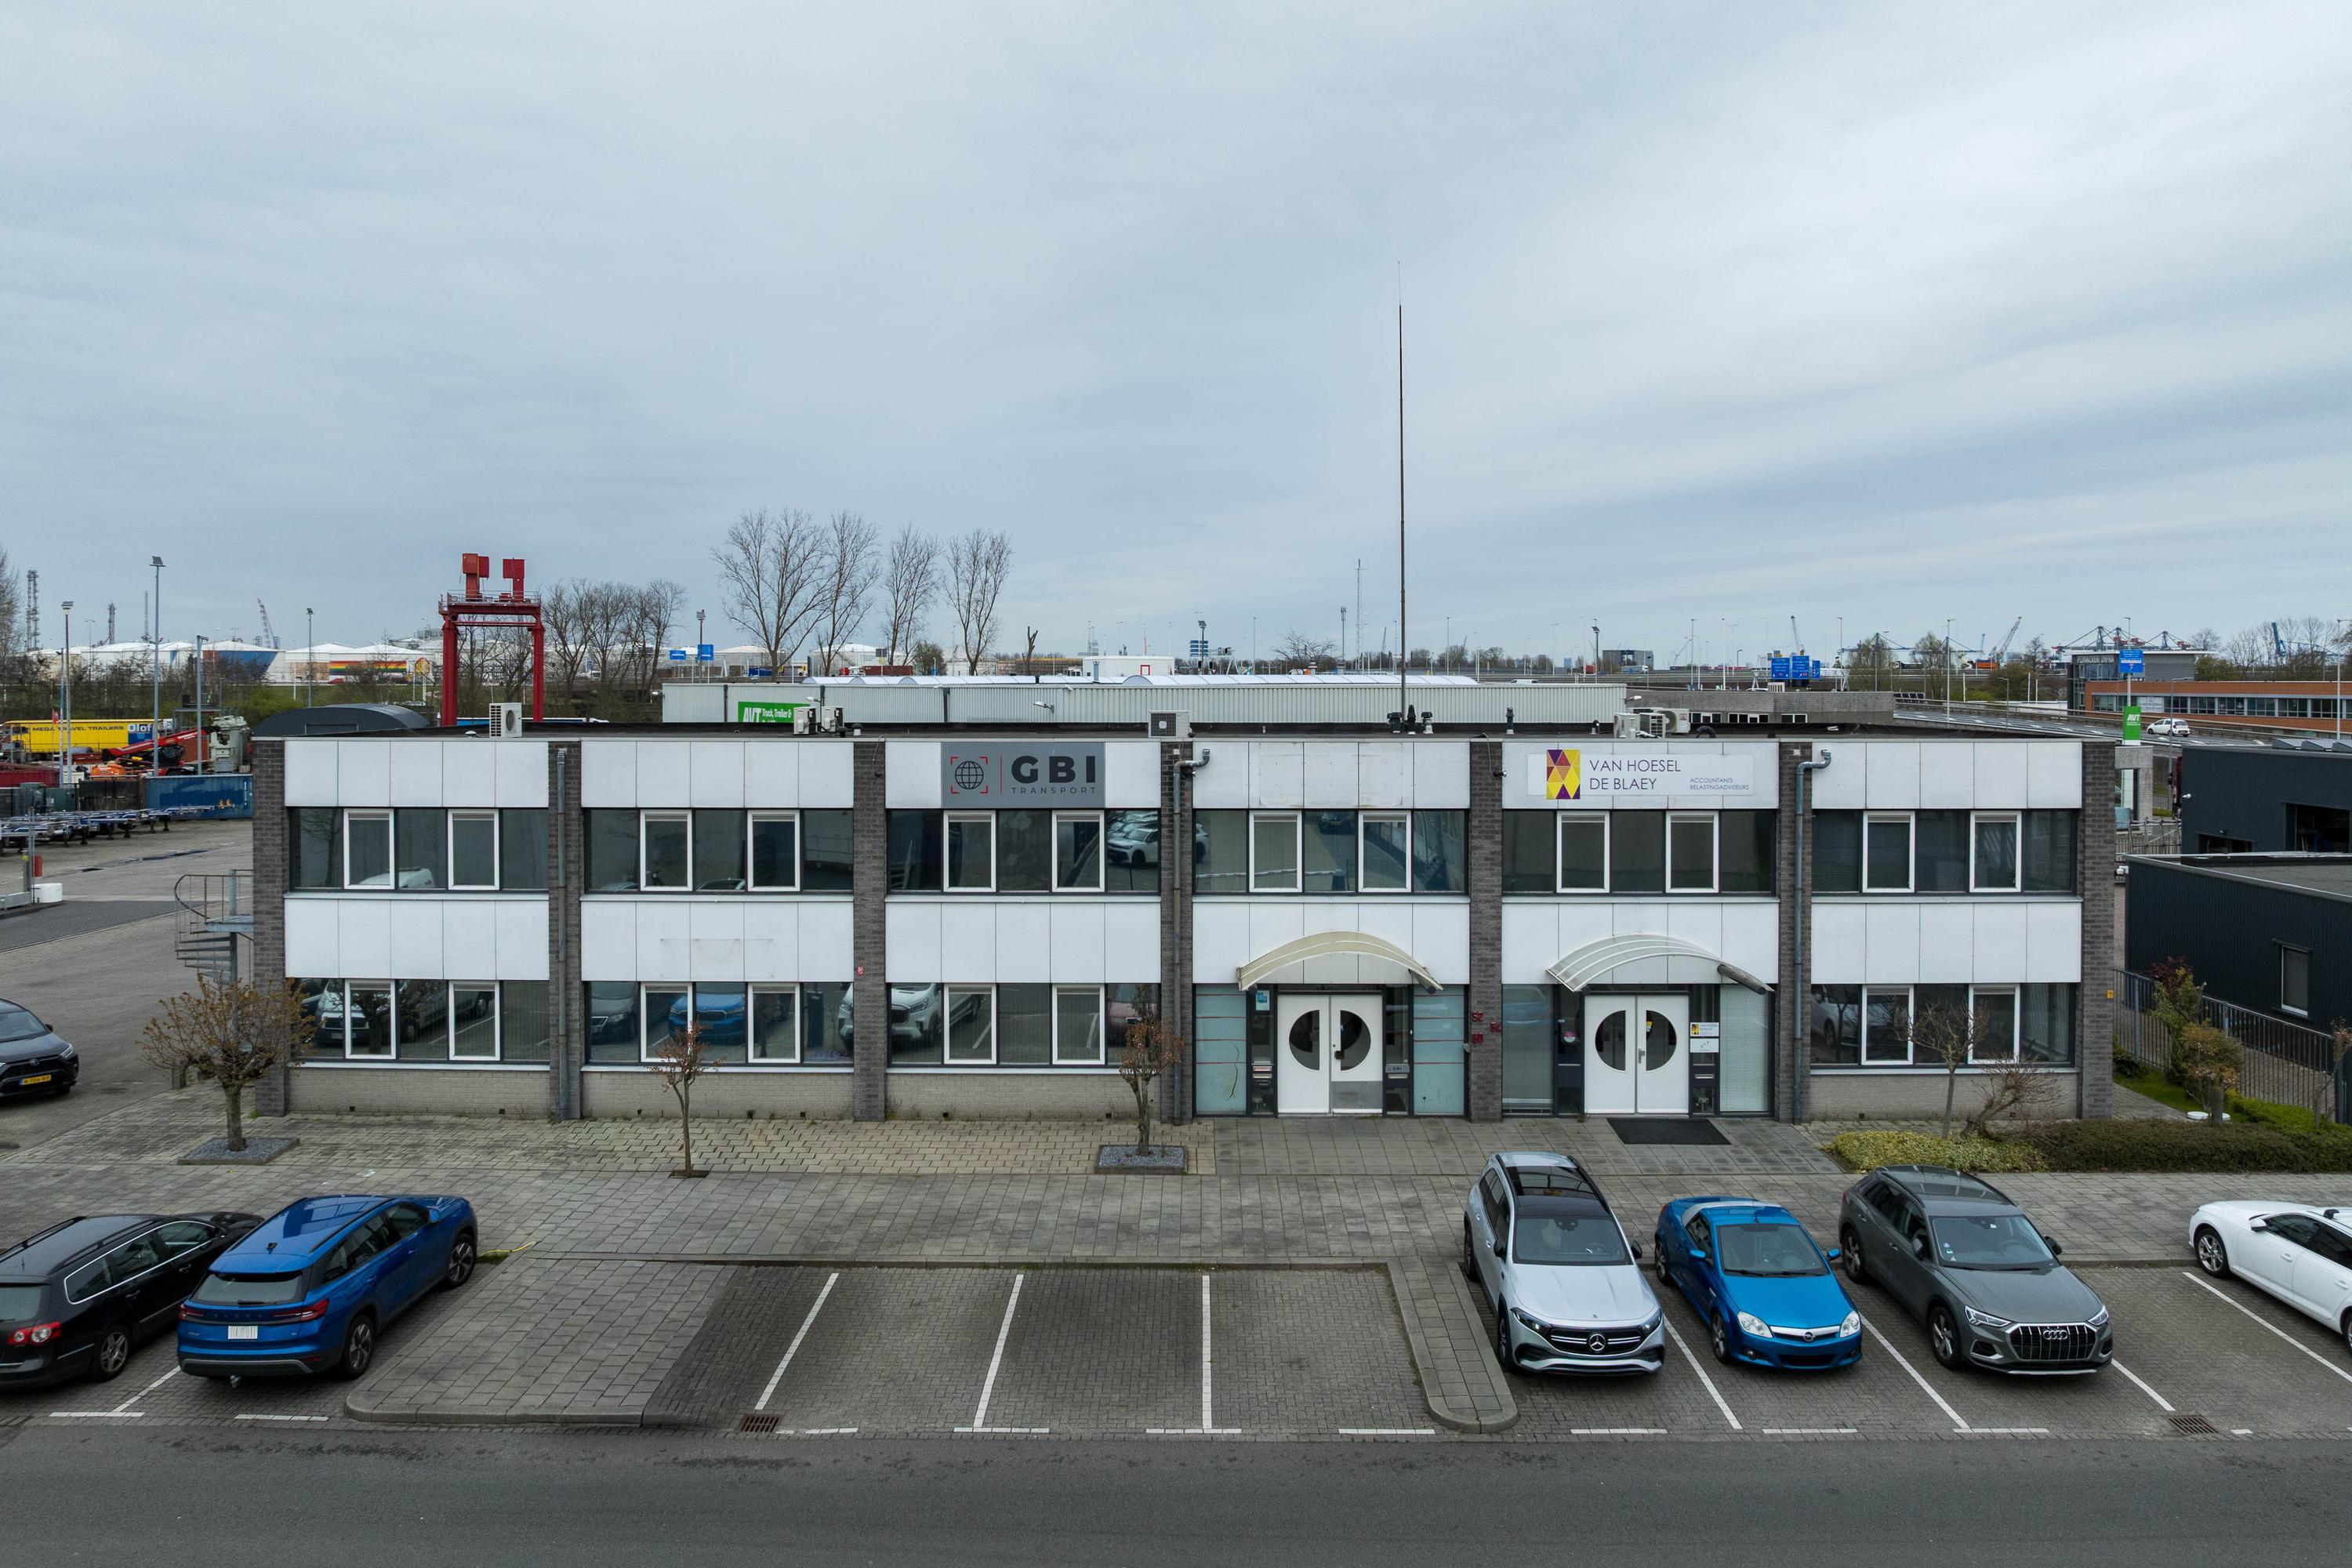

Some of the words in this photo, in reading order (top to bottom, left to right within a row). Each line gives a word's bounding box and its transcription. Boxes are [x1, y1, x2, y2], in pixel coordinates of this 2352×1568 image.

[1011, 756, 1096, 784] GBI
[1590, 760, 1621, 771] VAN
[1628, 760, 1681, 772] HOESEL
[1590, 778, 1608, 790] DE
[1613, 778, 1657, 790] BLAEY
